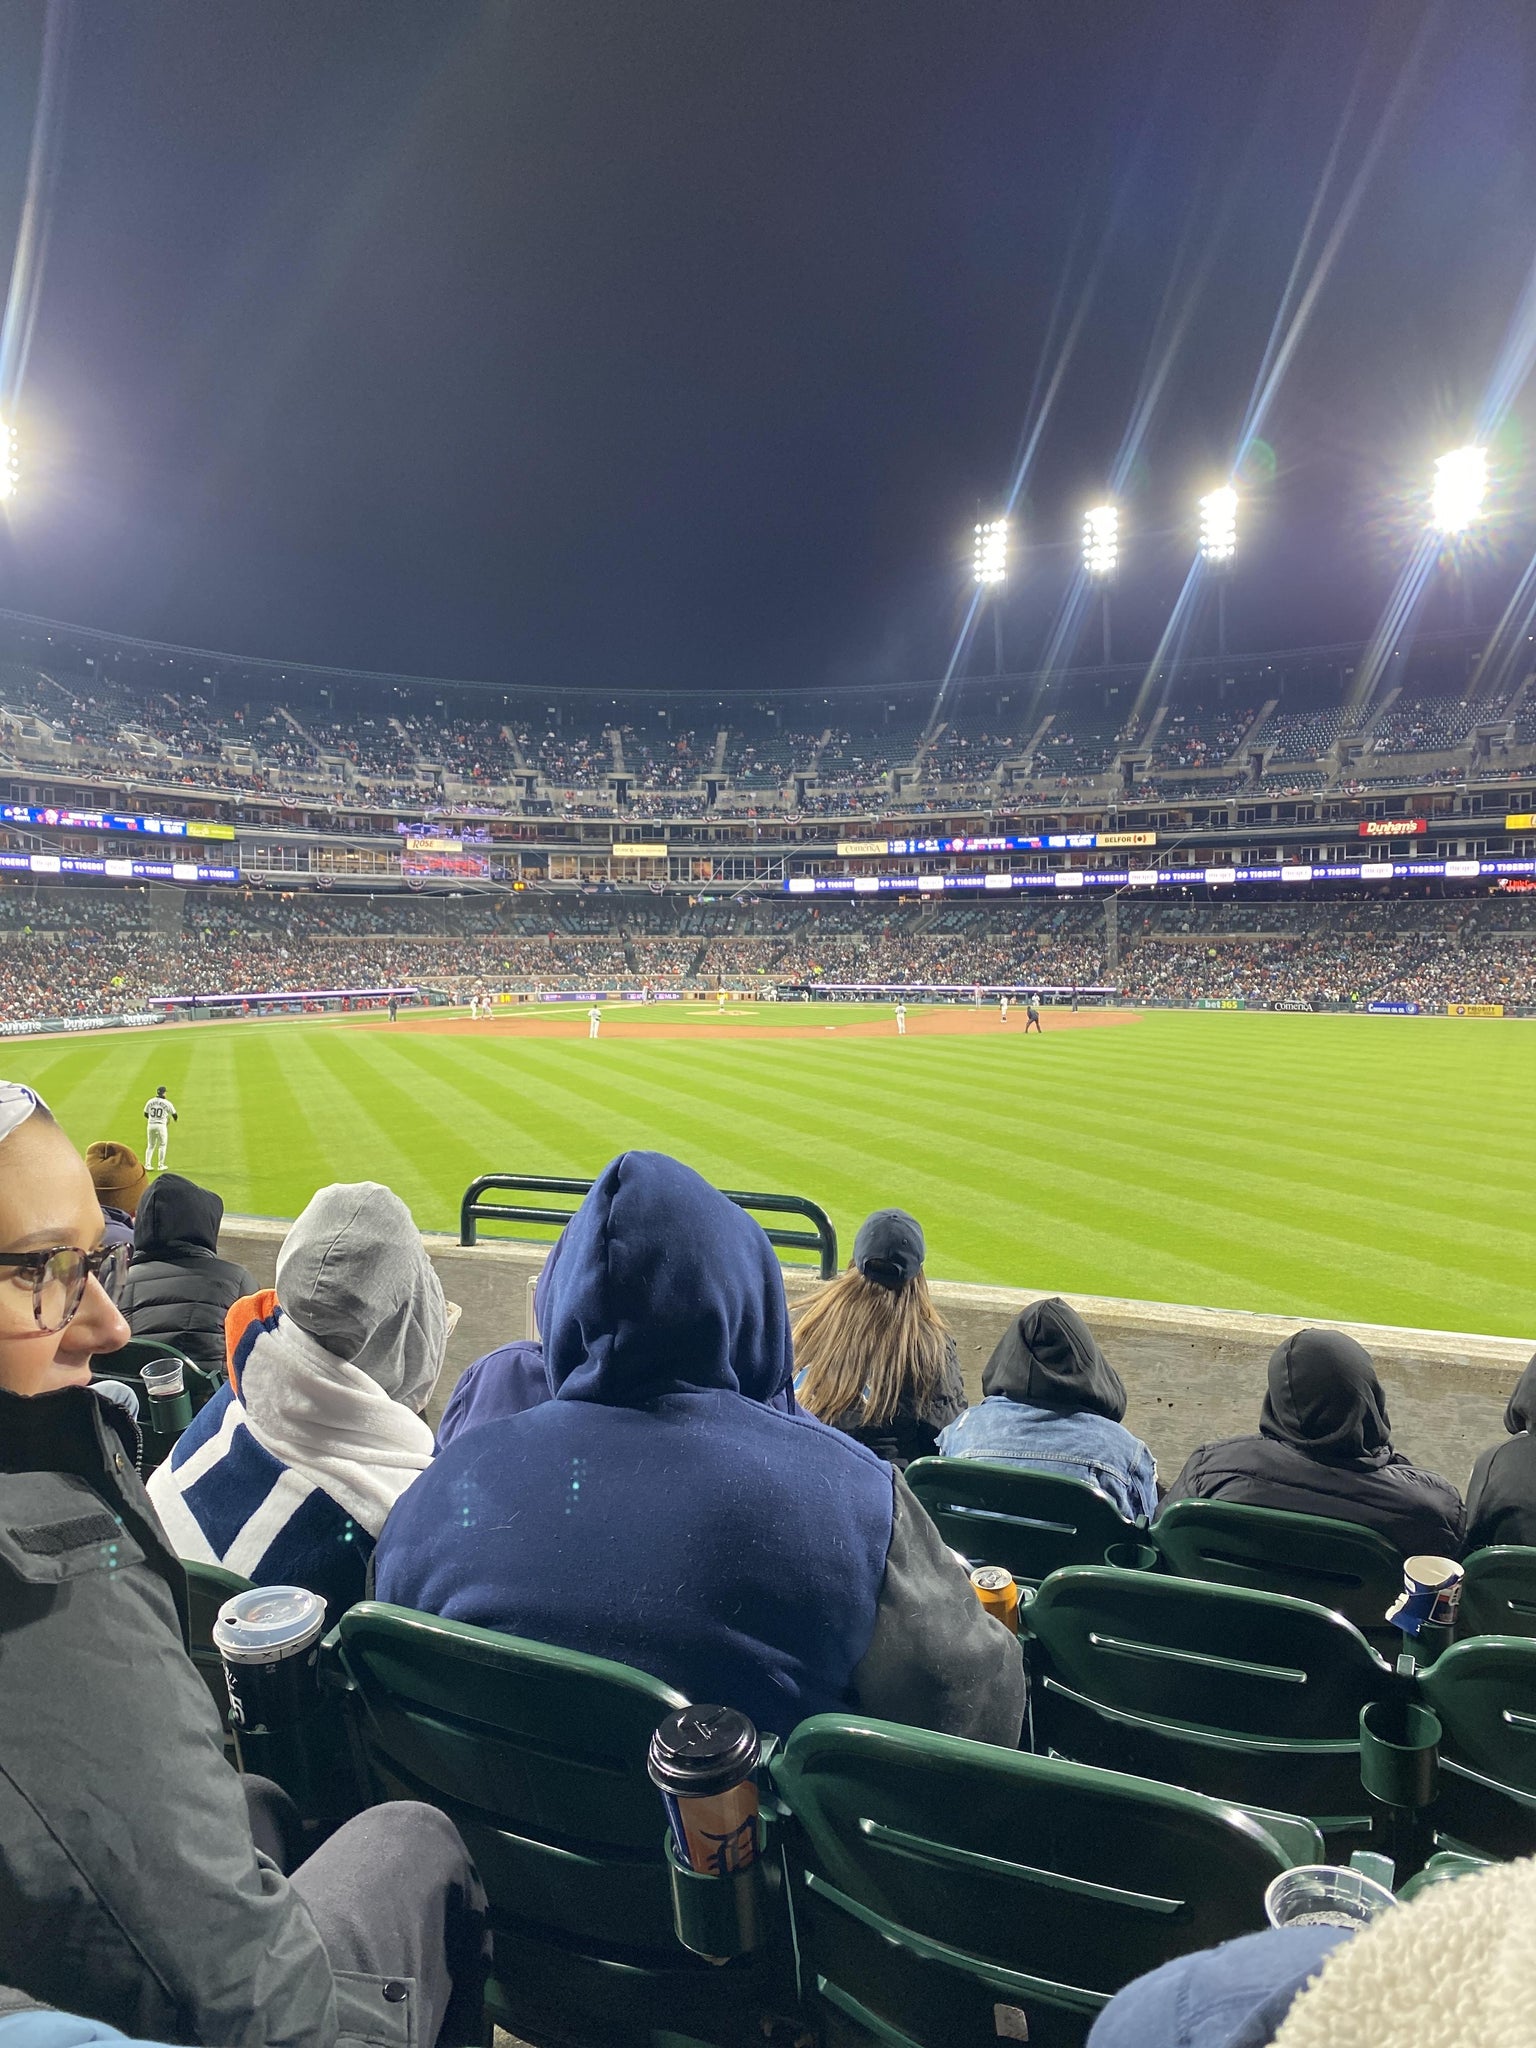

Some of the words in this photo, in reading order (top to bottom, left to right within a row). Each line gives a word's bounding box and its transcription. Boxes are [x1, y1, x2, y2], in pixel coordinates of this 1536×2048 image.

[1366, 820, 1417, 833] Dunham's
[412, 840, 433, 848] ROSE
[62, 860, 73, 869] GO
[75, 861, 104, 871] TIGERS!
[134, 865, 144, 873] GO
[145, 866, 171, 875] TIGERS!
[1395, 866, 1407, 874] GO
[1409, 865, 1444, 873] TIGERS!
[1481, 864, 1495, 872] GO
[1497, 863, 1534, 872] TIGERS!
[209, 869, 234, 878] TIGERS!
[1172, 872, 1204, 880] TIGERS!
[1250, 870, 1280, 878] TIGERS!
[1327, 867, 1359, 876] TIGERS!
[1025, 876, 1054, 884] TIGERS!
[1097, 874, 1127, 882] TIGERS!
[816, 881, 826, 889] GO
[1205, 1000, 1238, 1009] bet365
[64, 1016, 104, 1028] Dunham's
[150, 1107, 163, 1118] 30
